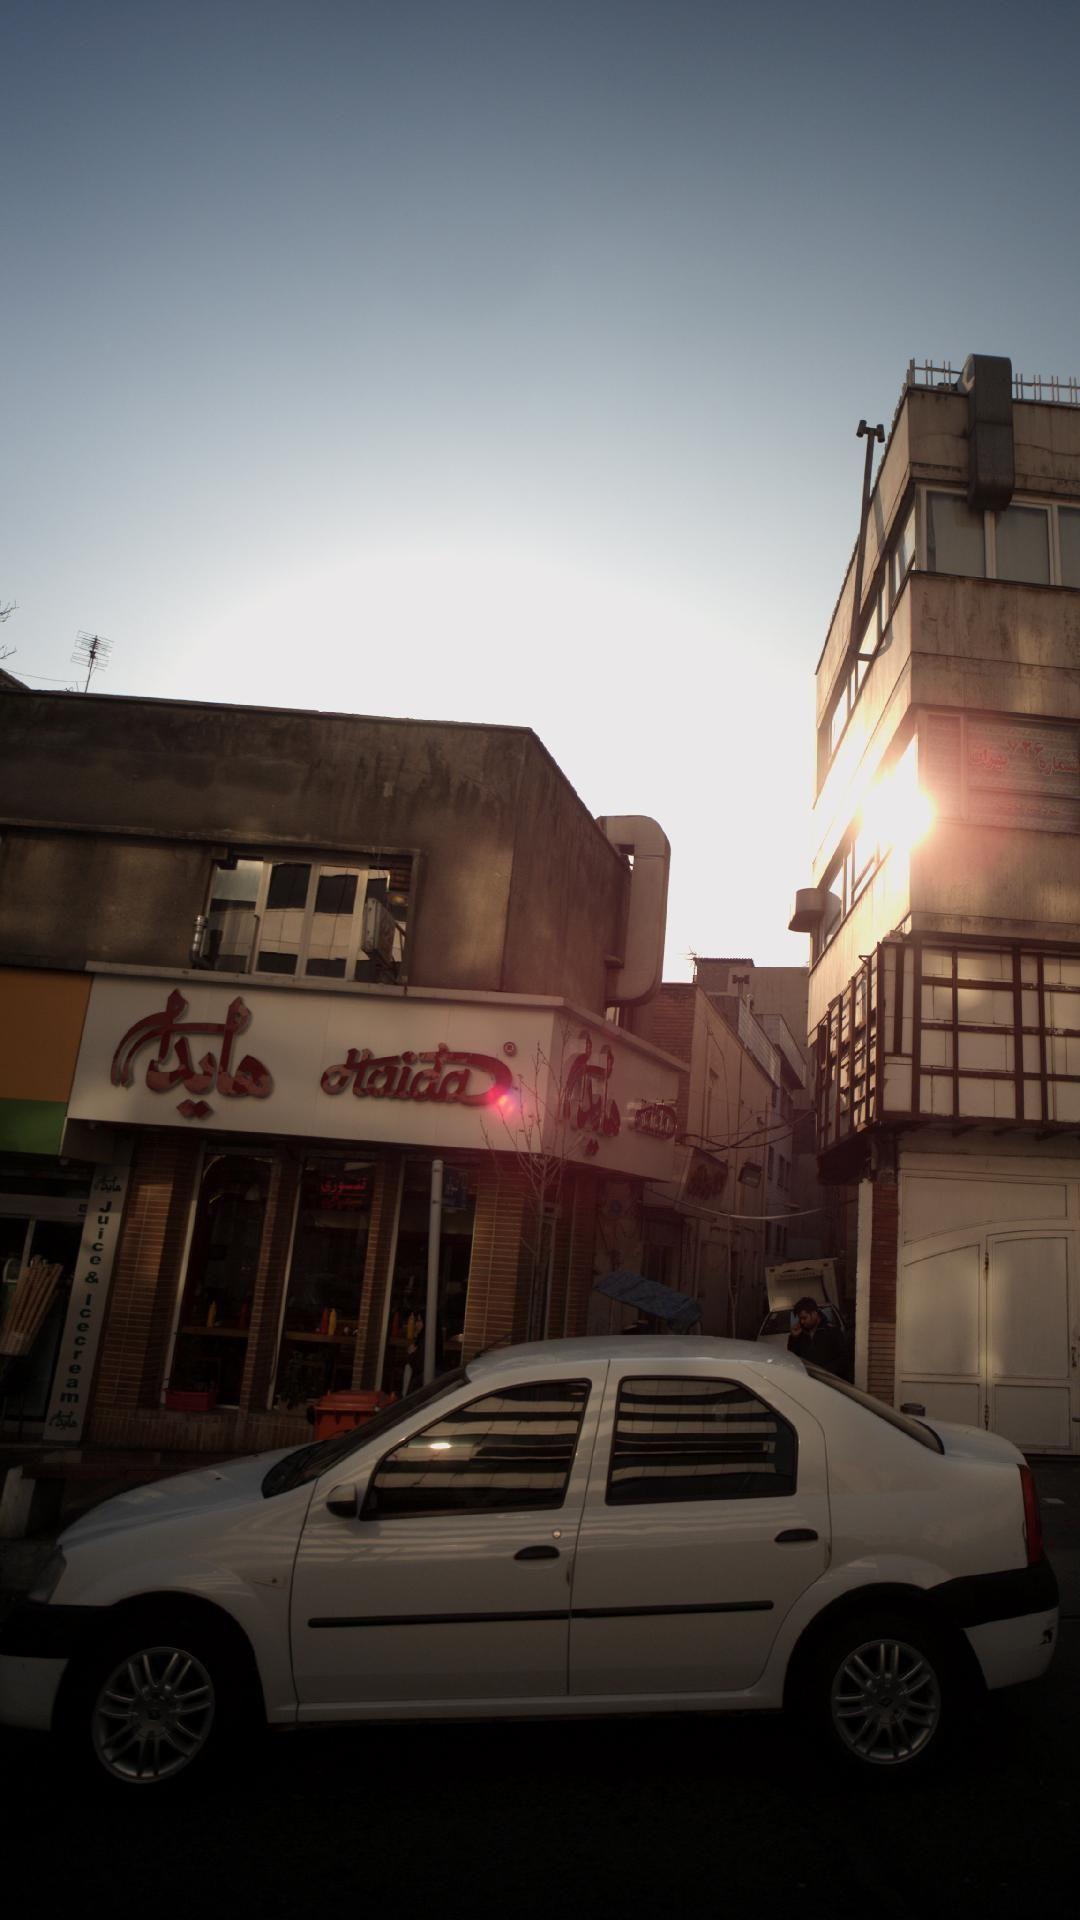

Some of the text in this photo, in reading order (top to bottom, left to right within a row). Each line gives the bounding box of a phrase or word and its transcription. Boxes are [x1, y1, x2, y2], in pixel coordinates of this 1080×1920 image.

[320, 1043, 513, 1106] Haida
[60, 1201, 112, 1403] Juice & Icecream
